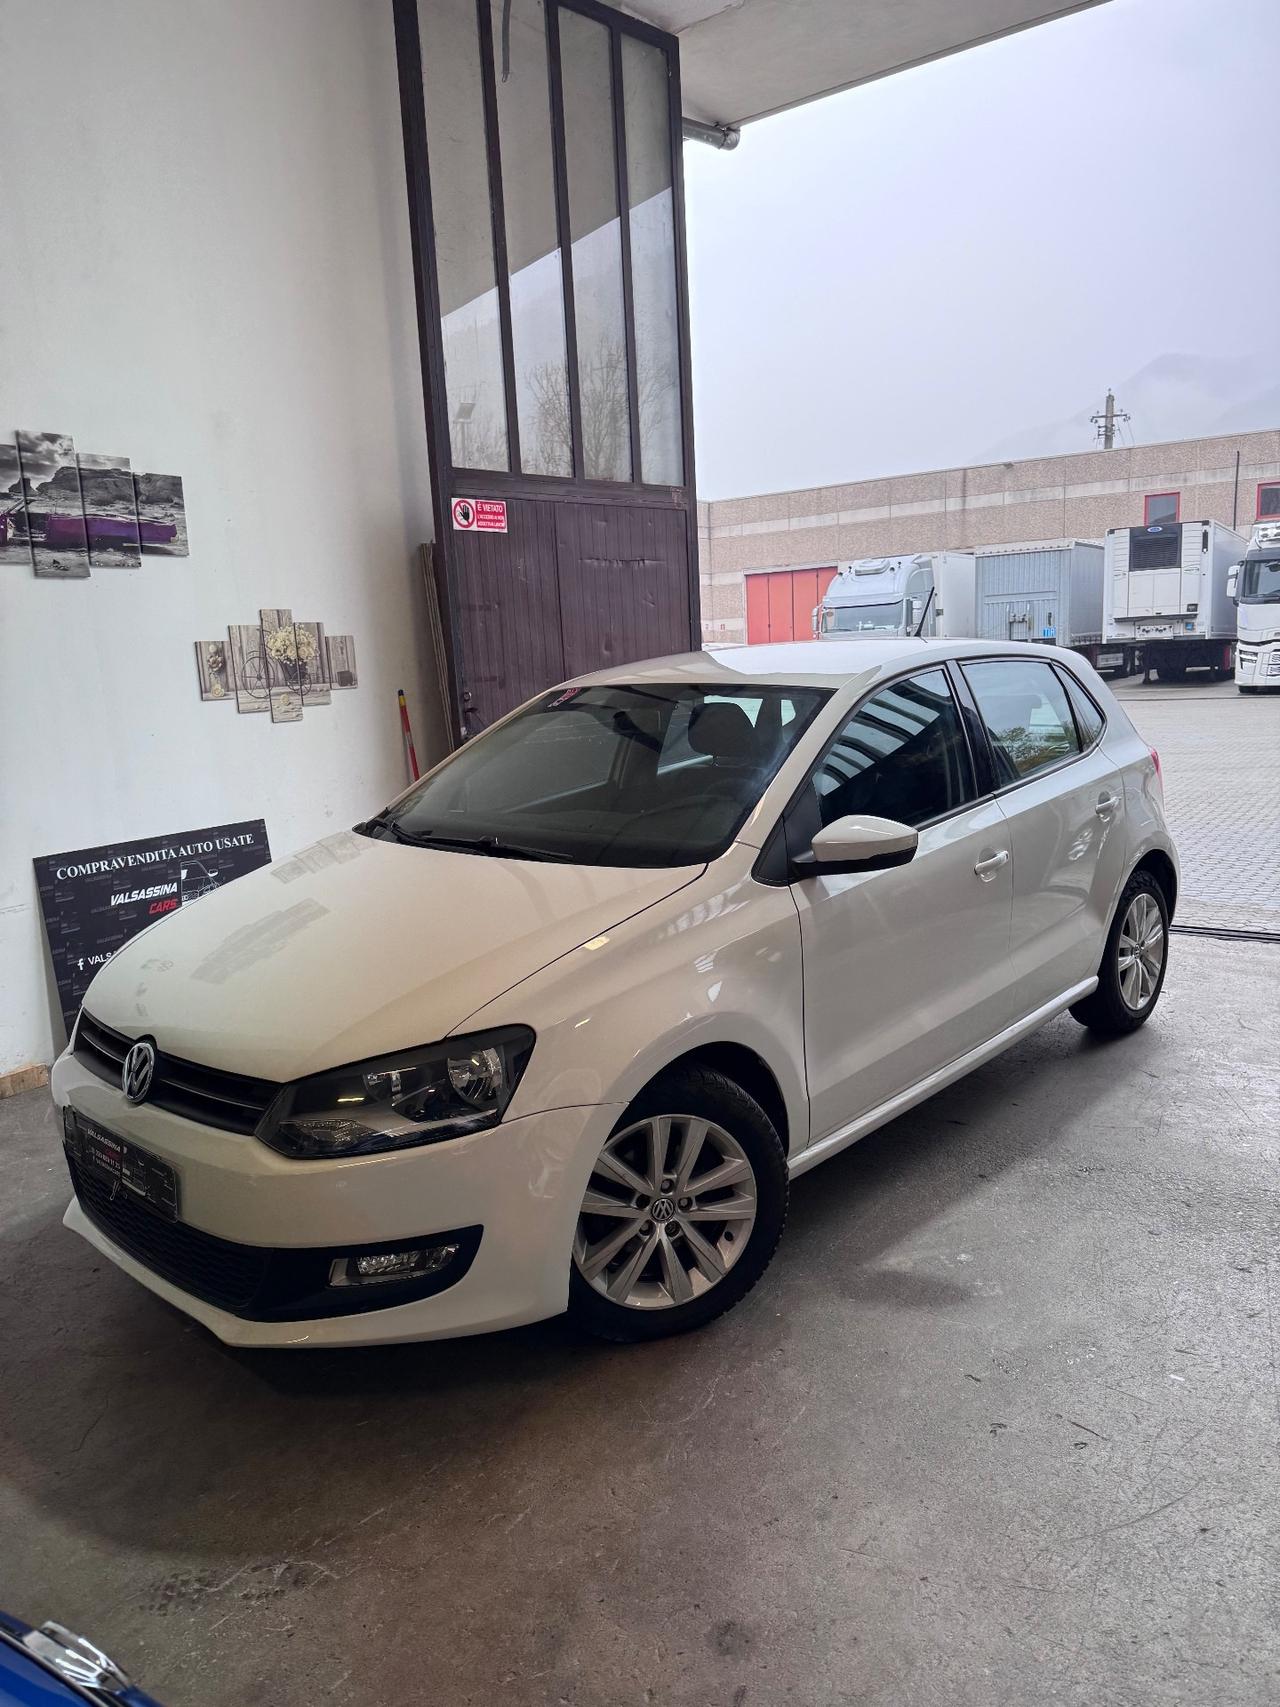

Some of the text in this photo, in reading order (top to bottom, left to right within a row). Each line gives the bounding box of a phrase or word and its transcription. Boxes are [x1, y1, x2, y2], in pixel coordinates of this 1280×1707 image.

[483, 504, 503, 512] VIETATO
[56, 848, 177, 880] COMPRAVENDITA
[179, 841, 213, 857] AUTO
[215, 833, 254, 850] USATE
[110, 882, 178, 906] VALSASSINA
[148, 898, 178, 915] CARS
